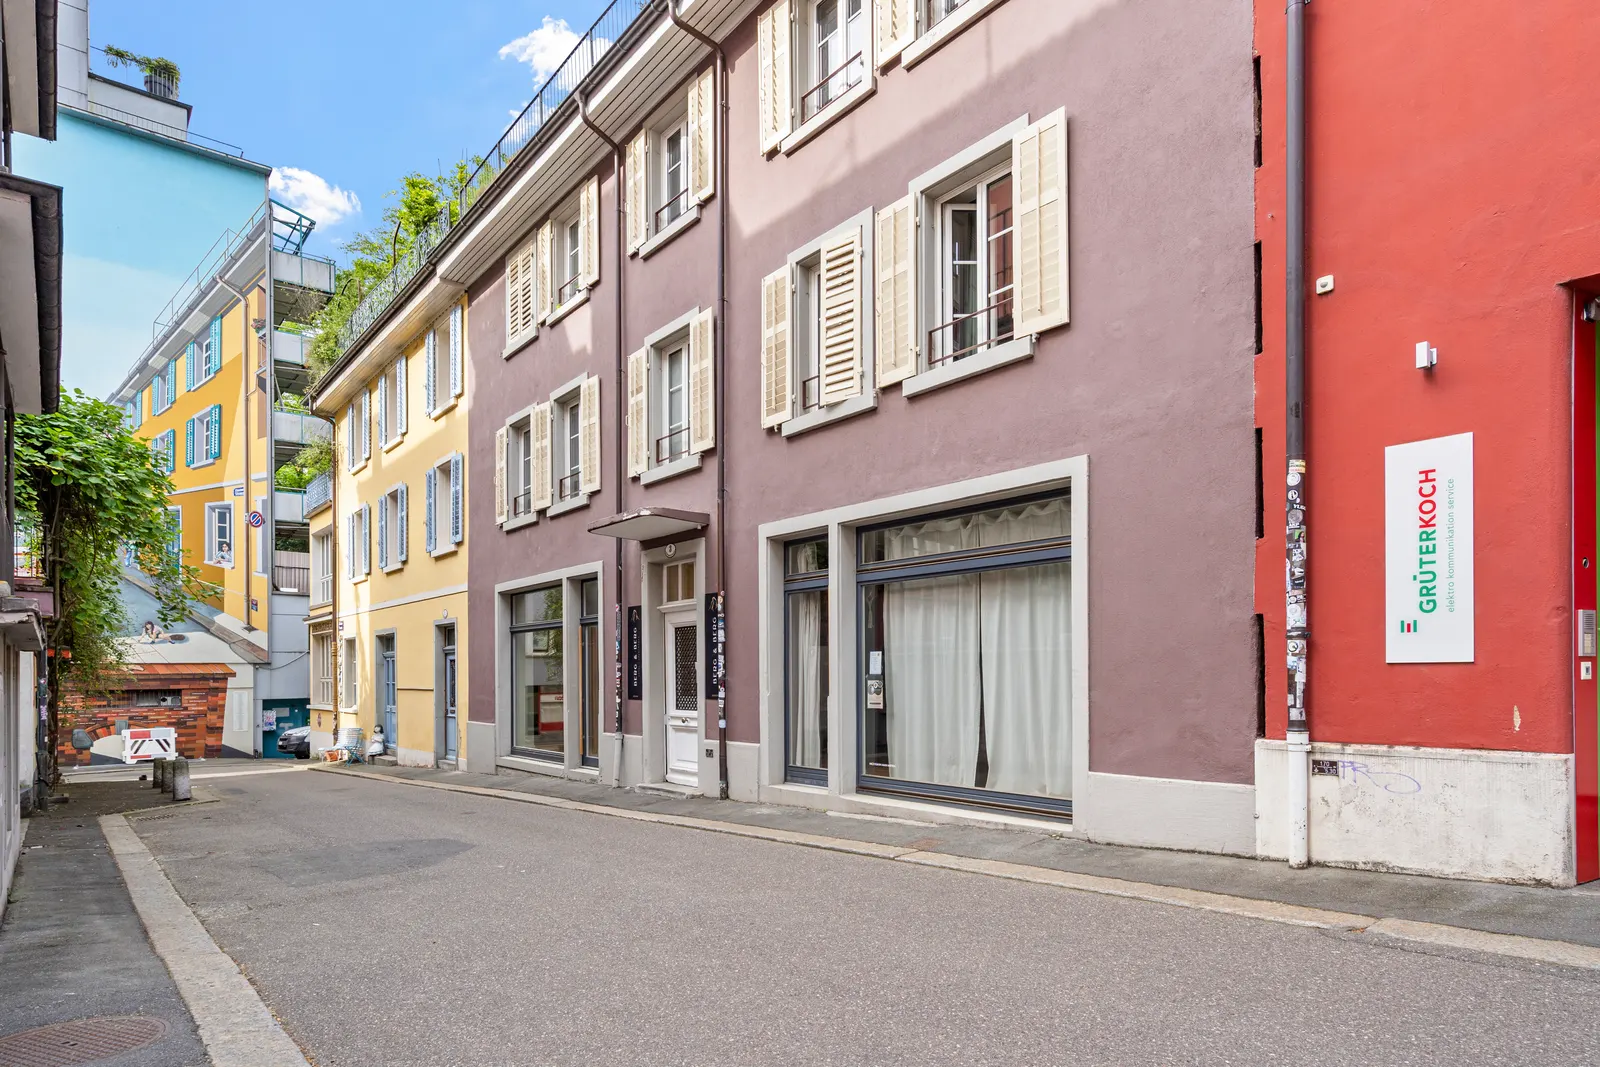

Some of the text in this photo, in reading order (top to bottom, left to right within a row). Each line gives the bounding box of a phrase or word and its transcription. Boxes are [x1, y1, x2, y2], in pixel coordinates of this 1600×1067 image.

[1412, 468, 1437, 614] GRÜTERKOCH
[1446, 478, 1455, 613] elektro kommunikation service
